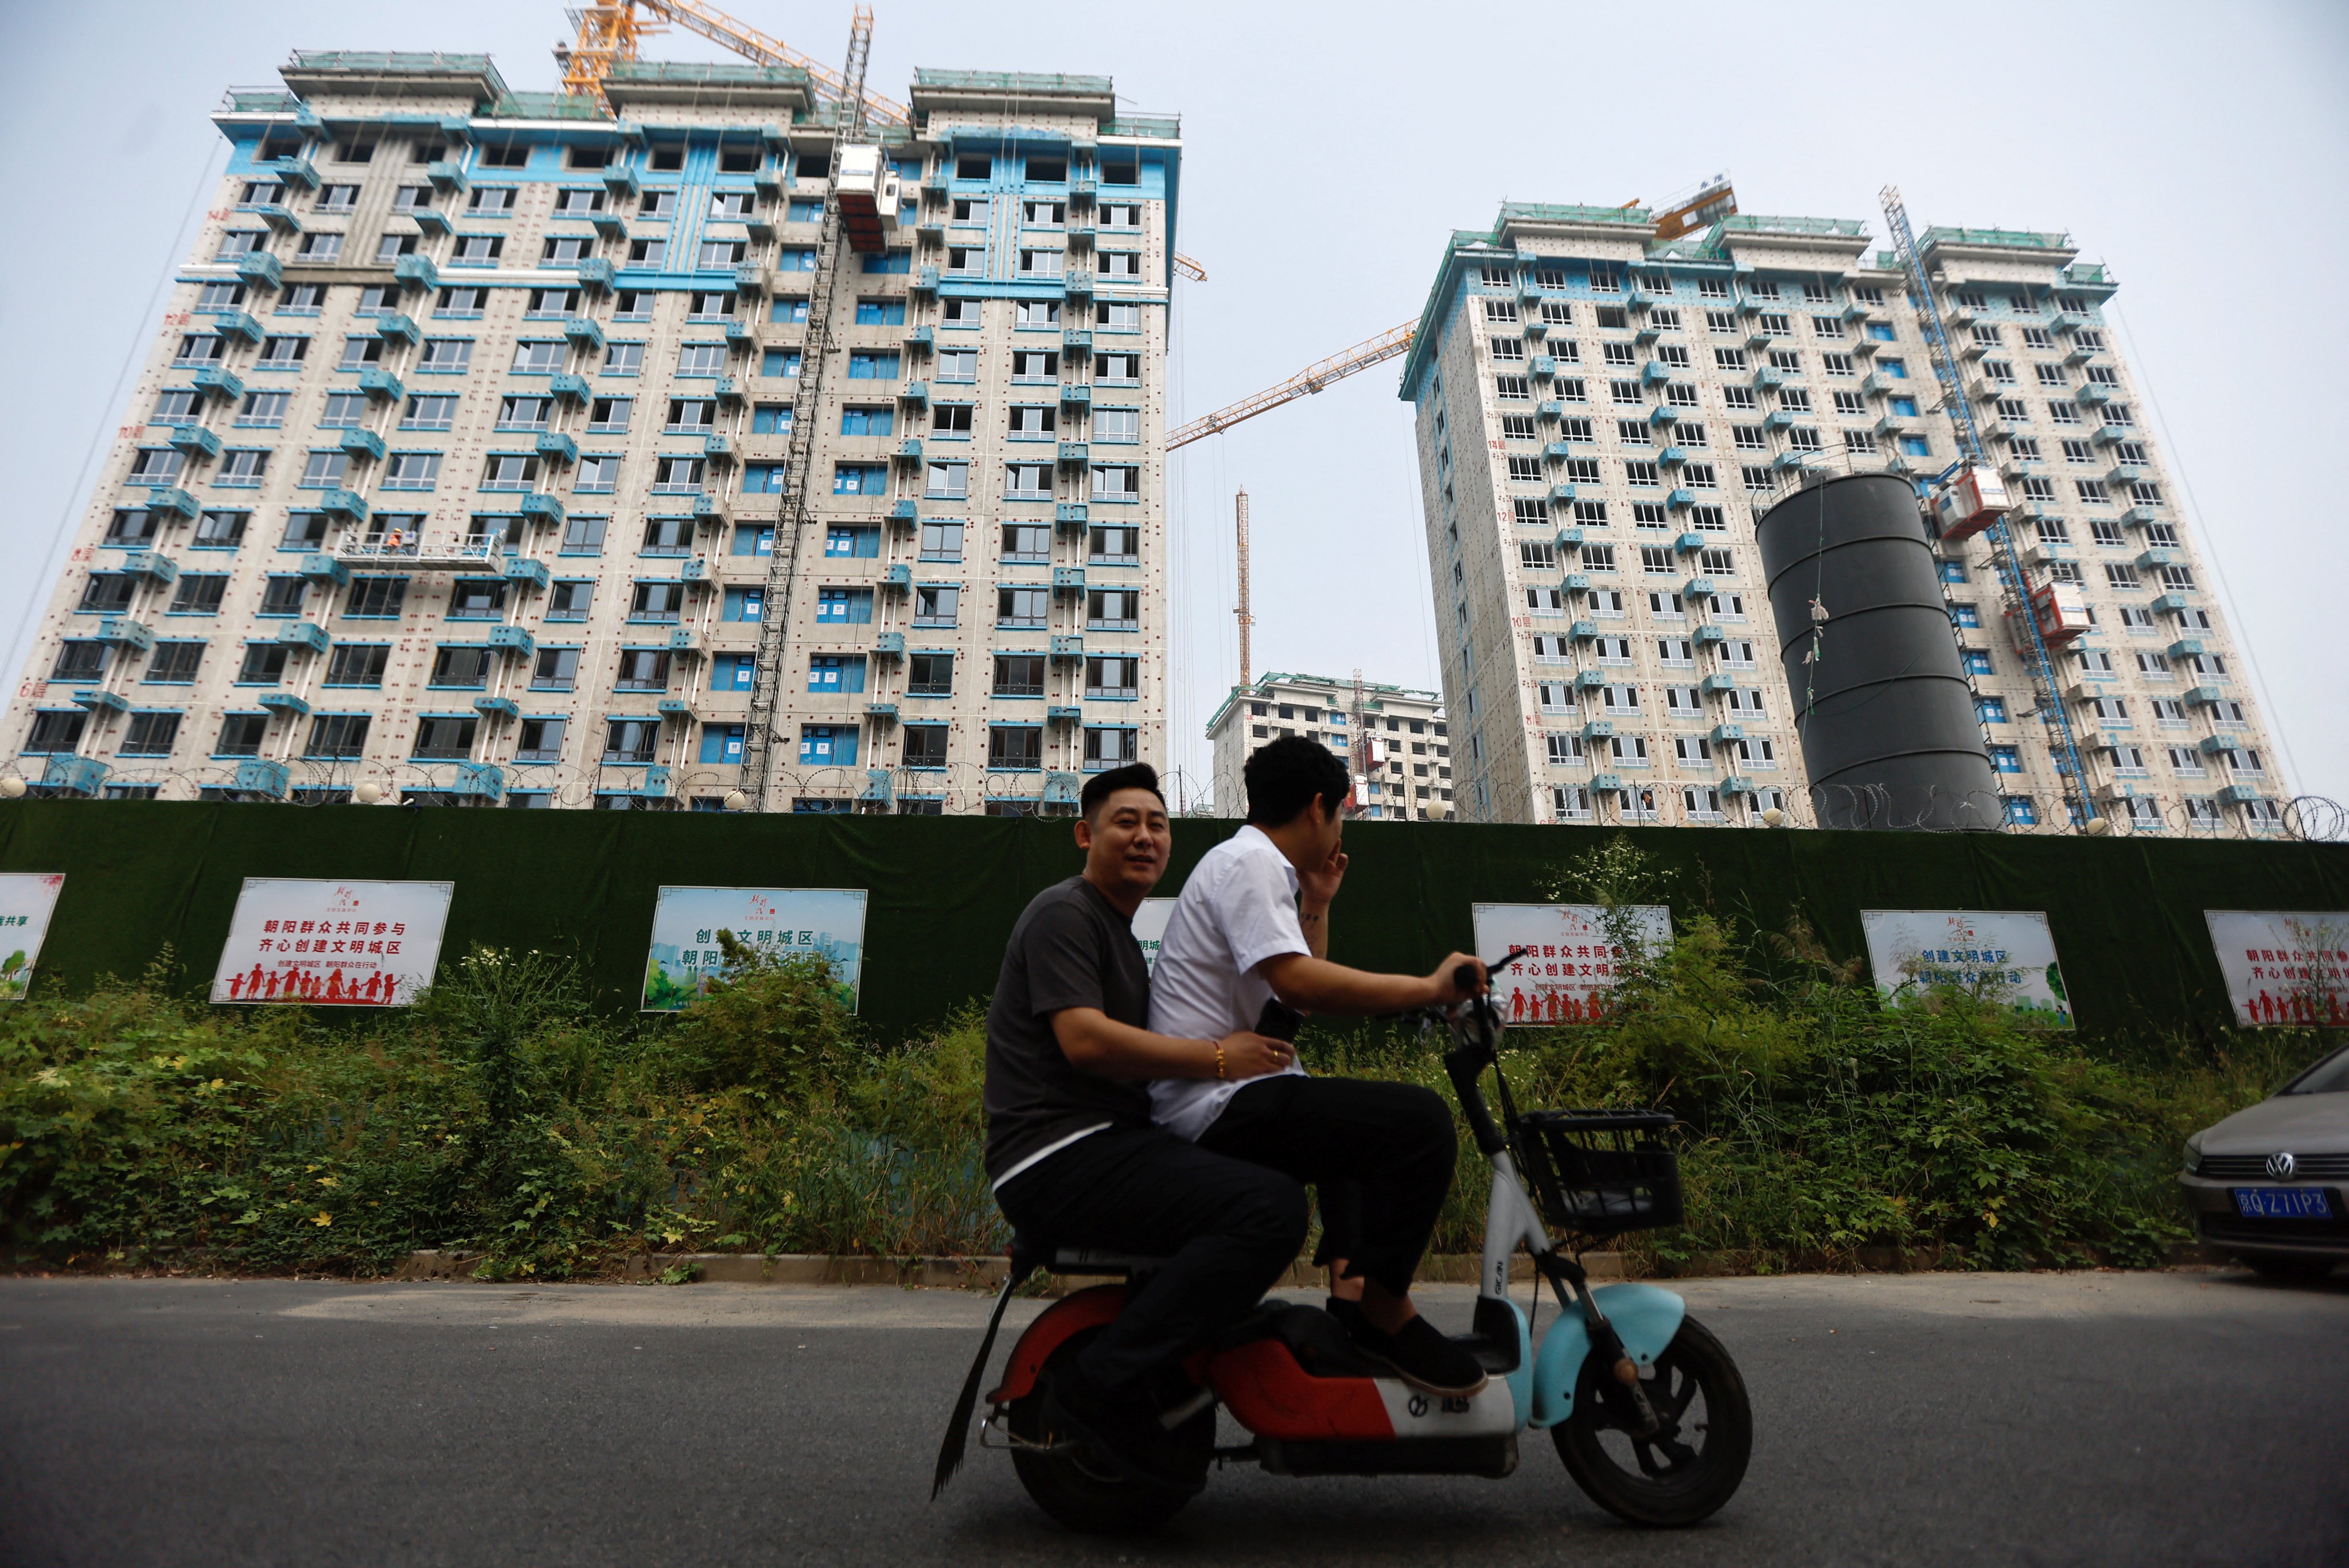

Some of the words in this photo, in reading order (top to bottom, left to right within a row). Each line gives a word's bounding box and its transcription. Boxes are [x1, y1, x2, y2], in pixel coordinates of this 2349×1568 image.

[1487, 440, 1506, 450] 14层
[1497, 512, 1516, 521] 12层
[1512, 617, 1532, 627] 10层
[20, 682, 48, 697] 6层
[1526, 715, 1541, 726] 8层
[263, 920, 405, 935] 朝阳群众共同参与
[696, 929, 813, 945] 创文明城区
[259, 938, 402, 954] 齐心创建文明城区
[1922, 950, 2009, 963] 创建文明城区
[326, 961, 377, 969] 朝阳群众在行动
